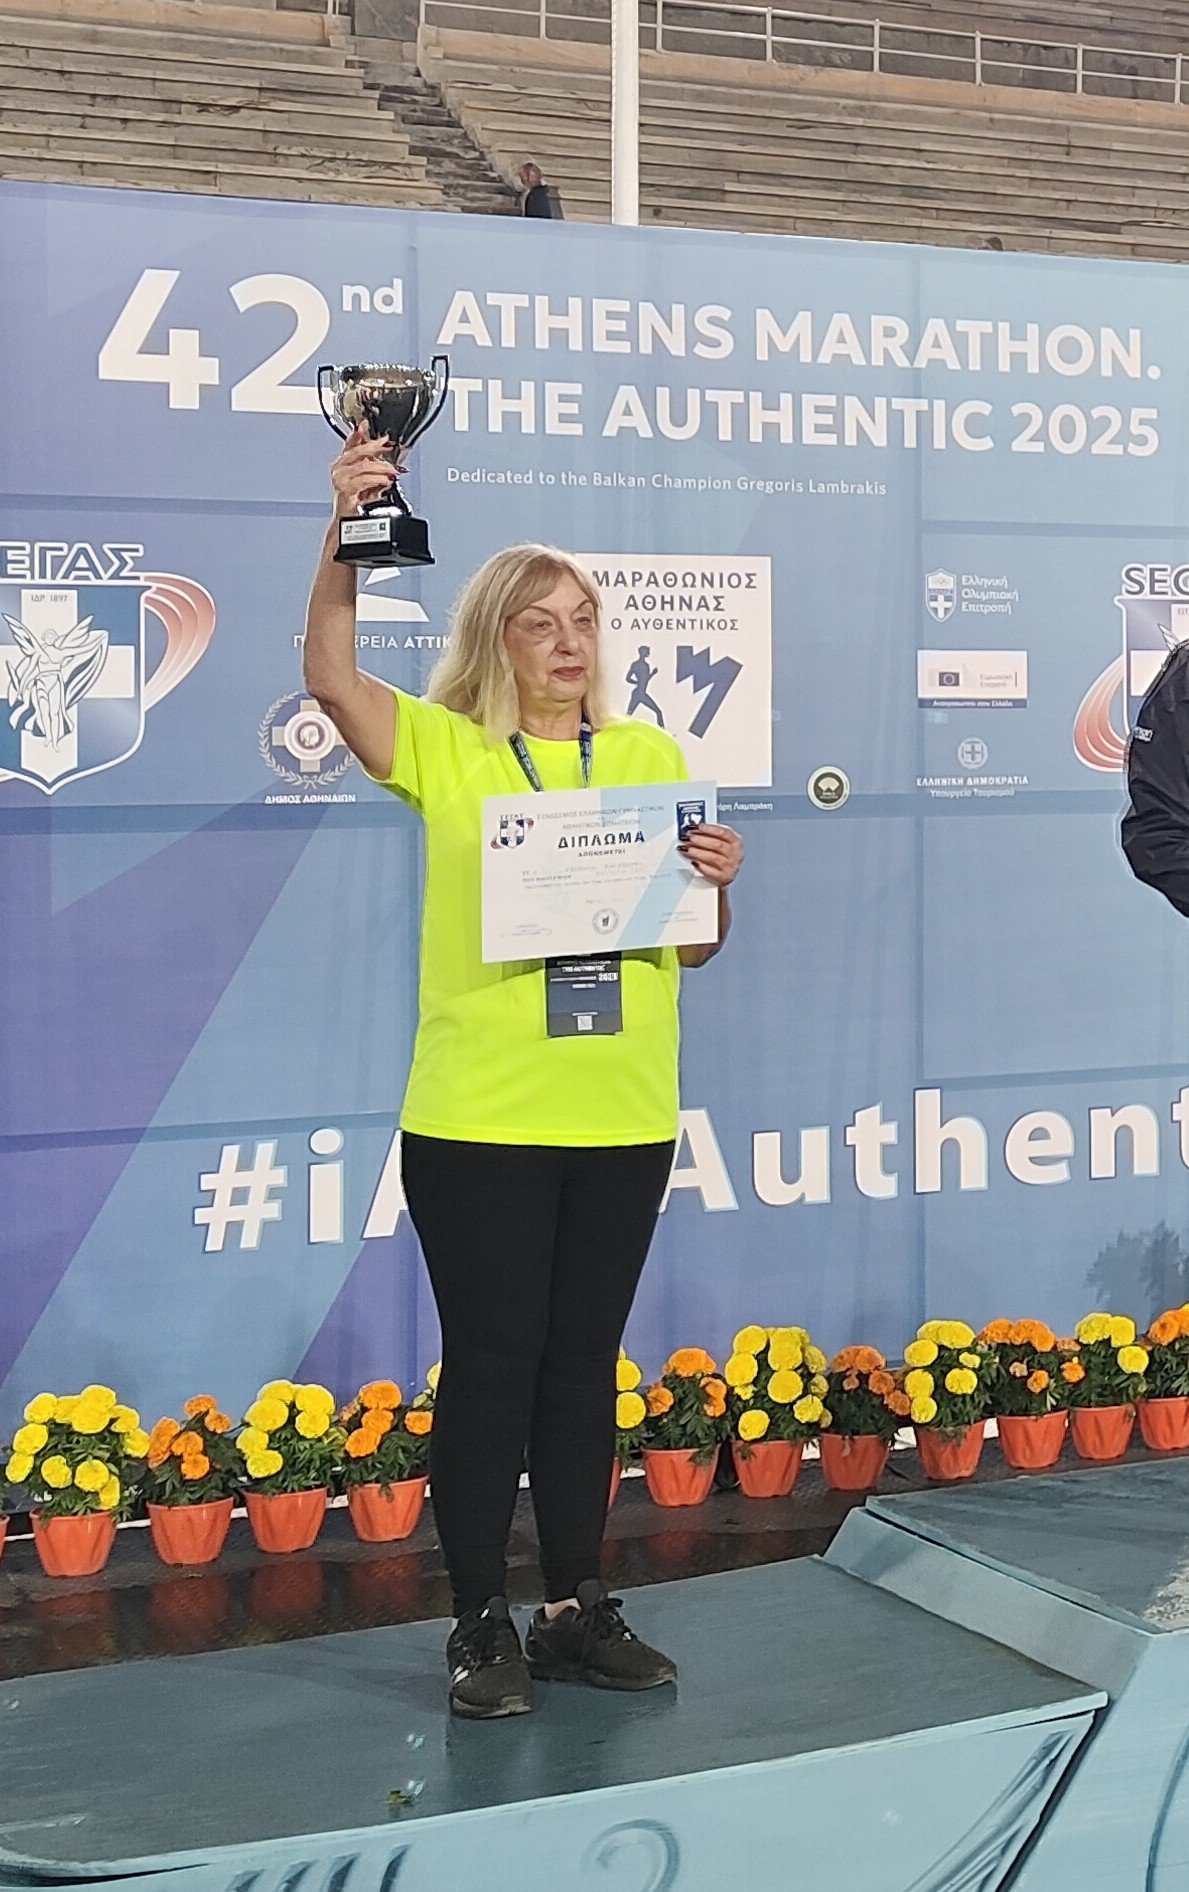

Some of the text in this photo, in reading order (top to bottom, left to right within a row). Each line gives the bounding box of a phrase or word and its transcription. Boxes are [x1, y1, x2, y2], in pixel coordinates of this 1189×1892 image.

[436, 290, 1162, 380] ATHENS MARATHON.
[448, 376, 1160, 457] THE AUTHENTIC 2025
[446, 467, 888, 496] Dedicated to the Balkan Champion Gregoris Lambrakis
[592, 570, 758, 590] ΜΑΡΑΘΩΝΙΟΣ
[961, 574, 1008, 590] Ελληνική
[624, 594, 726, 612] ΑΘΗΝΑΣ
[961, 588, 1019, 603] Ολυμπιακή
[961, 601, 1012, 617] Επιτροπή
[611, 618, 739, 631] Ο ΑΥΘΕΝΤΙΚΟΣ
[264, 794, 302, 805] ΔΗΜΟΣ
[558, 831, 645, 849] ΔΙΠΛΩΜΑ
